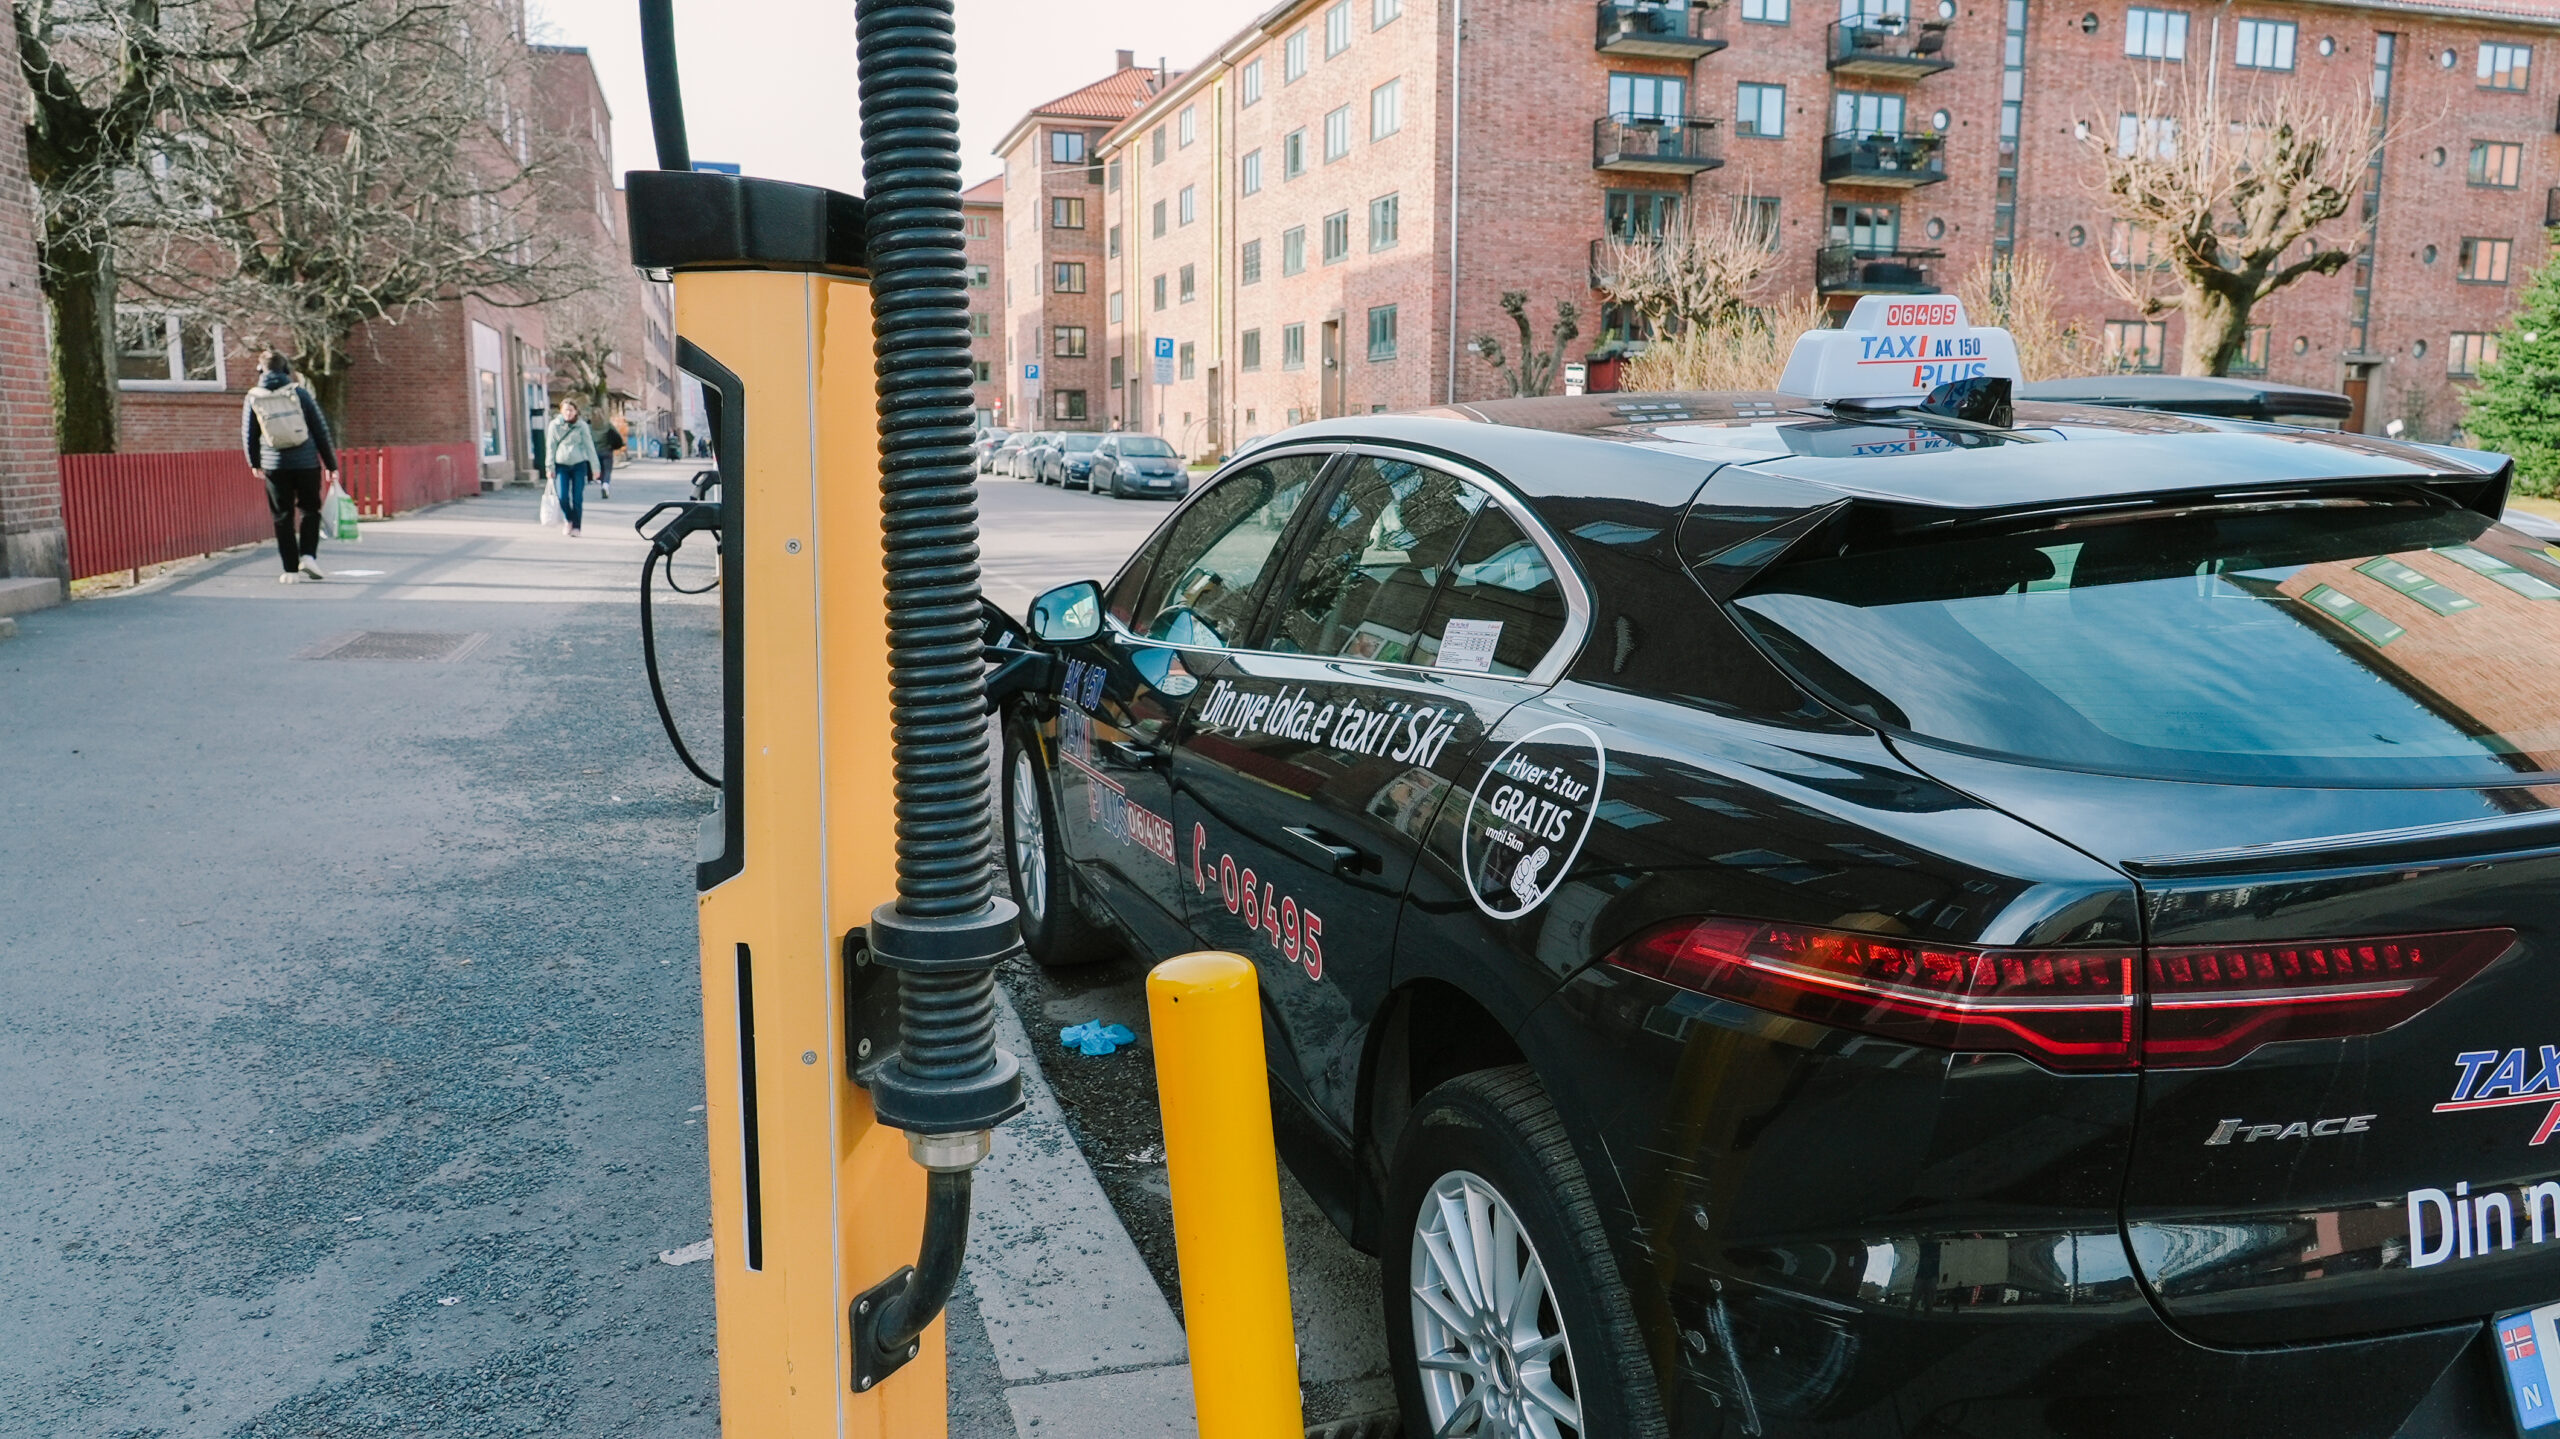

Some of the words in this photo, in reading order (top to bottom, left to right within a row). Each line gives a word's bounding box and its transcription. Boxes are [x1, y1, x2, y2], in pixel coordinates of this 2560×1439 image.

[1886, 304, 1957, 326] 06495
[1860, 335, 1928, 359] TAXI
[1935, 339, 1953, 357] AK
[1959, 337, 1981, 356] 150
[1061, 658, 1086, 703] AK
[1081, 664, 1107, 711] 150
[1199, 679, 1236, 725] Din
[1060, 704, 1090, 765] TAXI
[1227, 692, 1270, 738] nye
[1330, 697, 1398, 755] taxi
[1377, 704, 1412, 758] i
[1391, 707, 1465, 768] Ski
[1506, 752, 1548, 786] Hver
[1544, 766, 1589, 802] 5.tur
[1088, 776, 1130, 847] PLUS
[1126, 798, 1176, 865] 06495
[1490, 785, 1573, 842] GRATIS
[1505, 831, 1524, 852] 5km
[2408, 1181, 2513, 1269] Din
[2522, 1383, 2543, 1410] N
